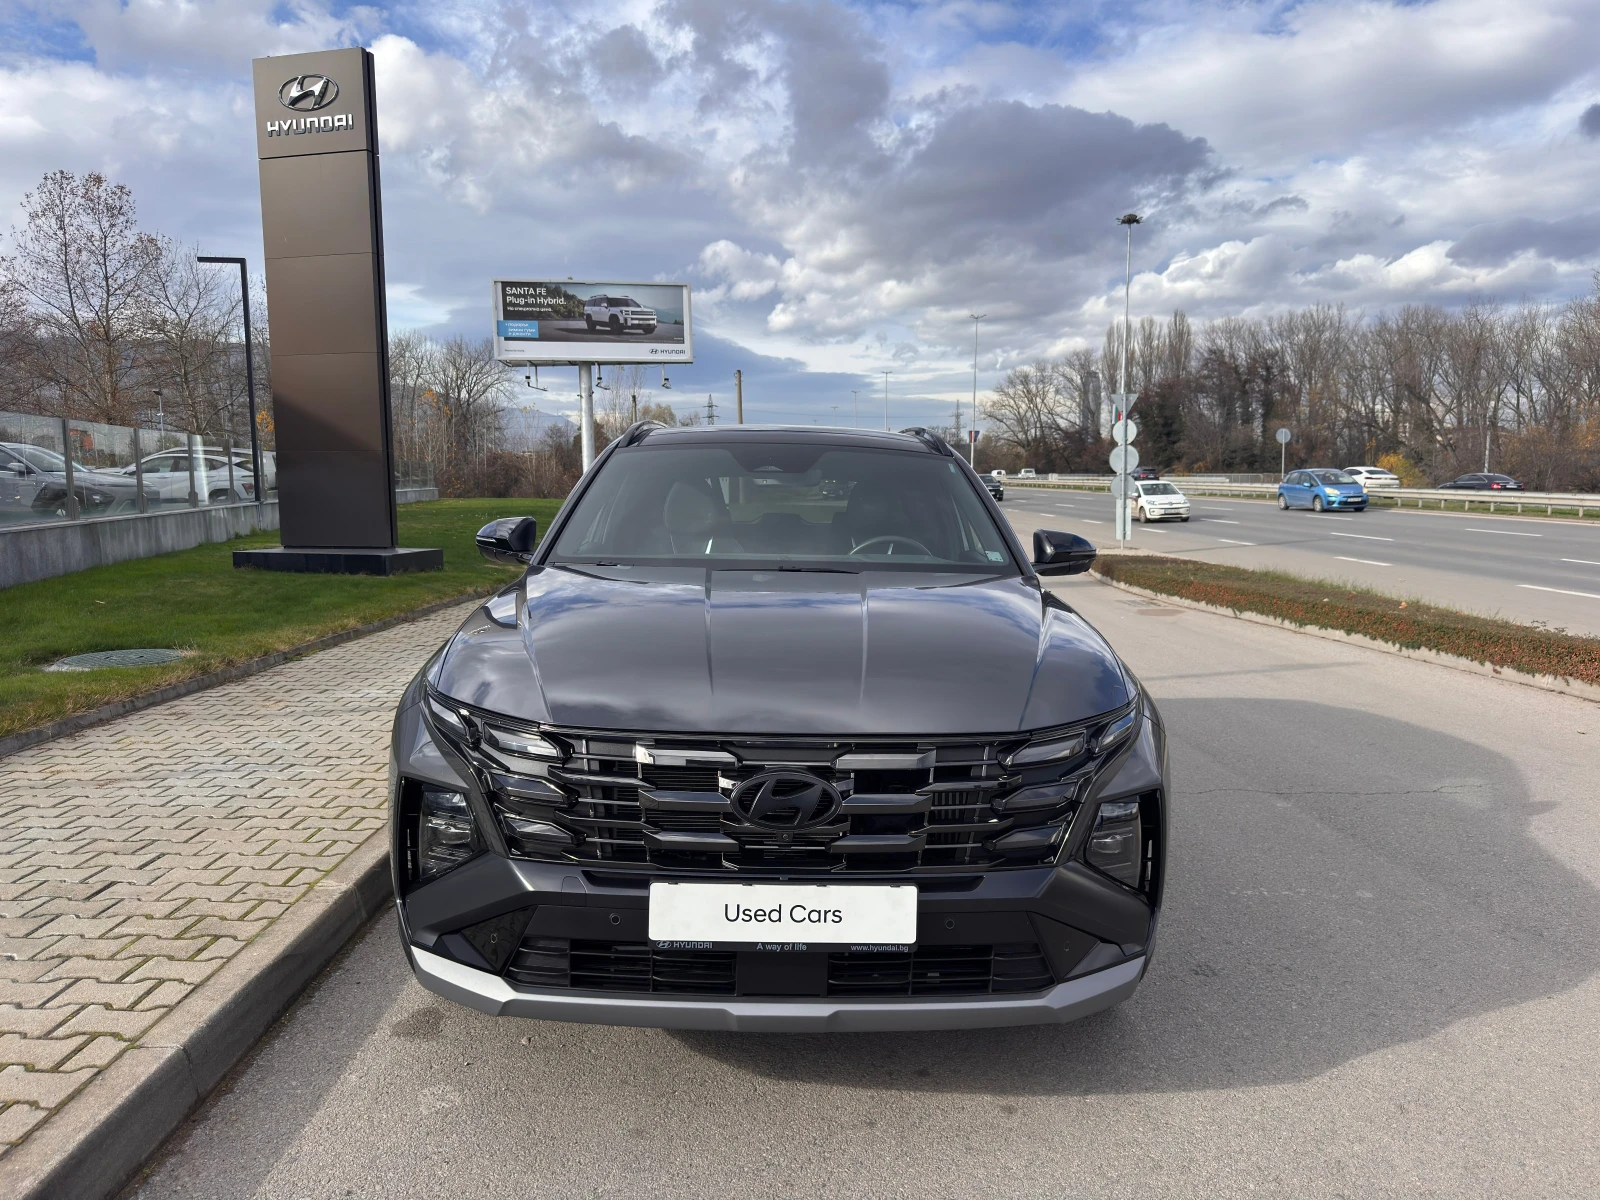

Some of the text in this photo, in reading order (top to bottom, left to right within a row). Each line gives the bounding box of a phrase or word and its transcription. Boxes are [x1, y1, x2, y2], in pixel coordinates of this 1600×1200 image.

[267, 114, 354, 137] HYUNDAI
[505, 286, 547, 295] SANTA FE
[506, 296, 567, 306] Plug-in Hybrid.
[724, 903, 843, 924] Used Cars
[673, 941, 713, 949] HYUNDAI
[765, 944, 782, 952] way
[794, 943, 807, 951] life
[850, 944, 909, 953] www.hyundai.bg
